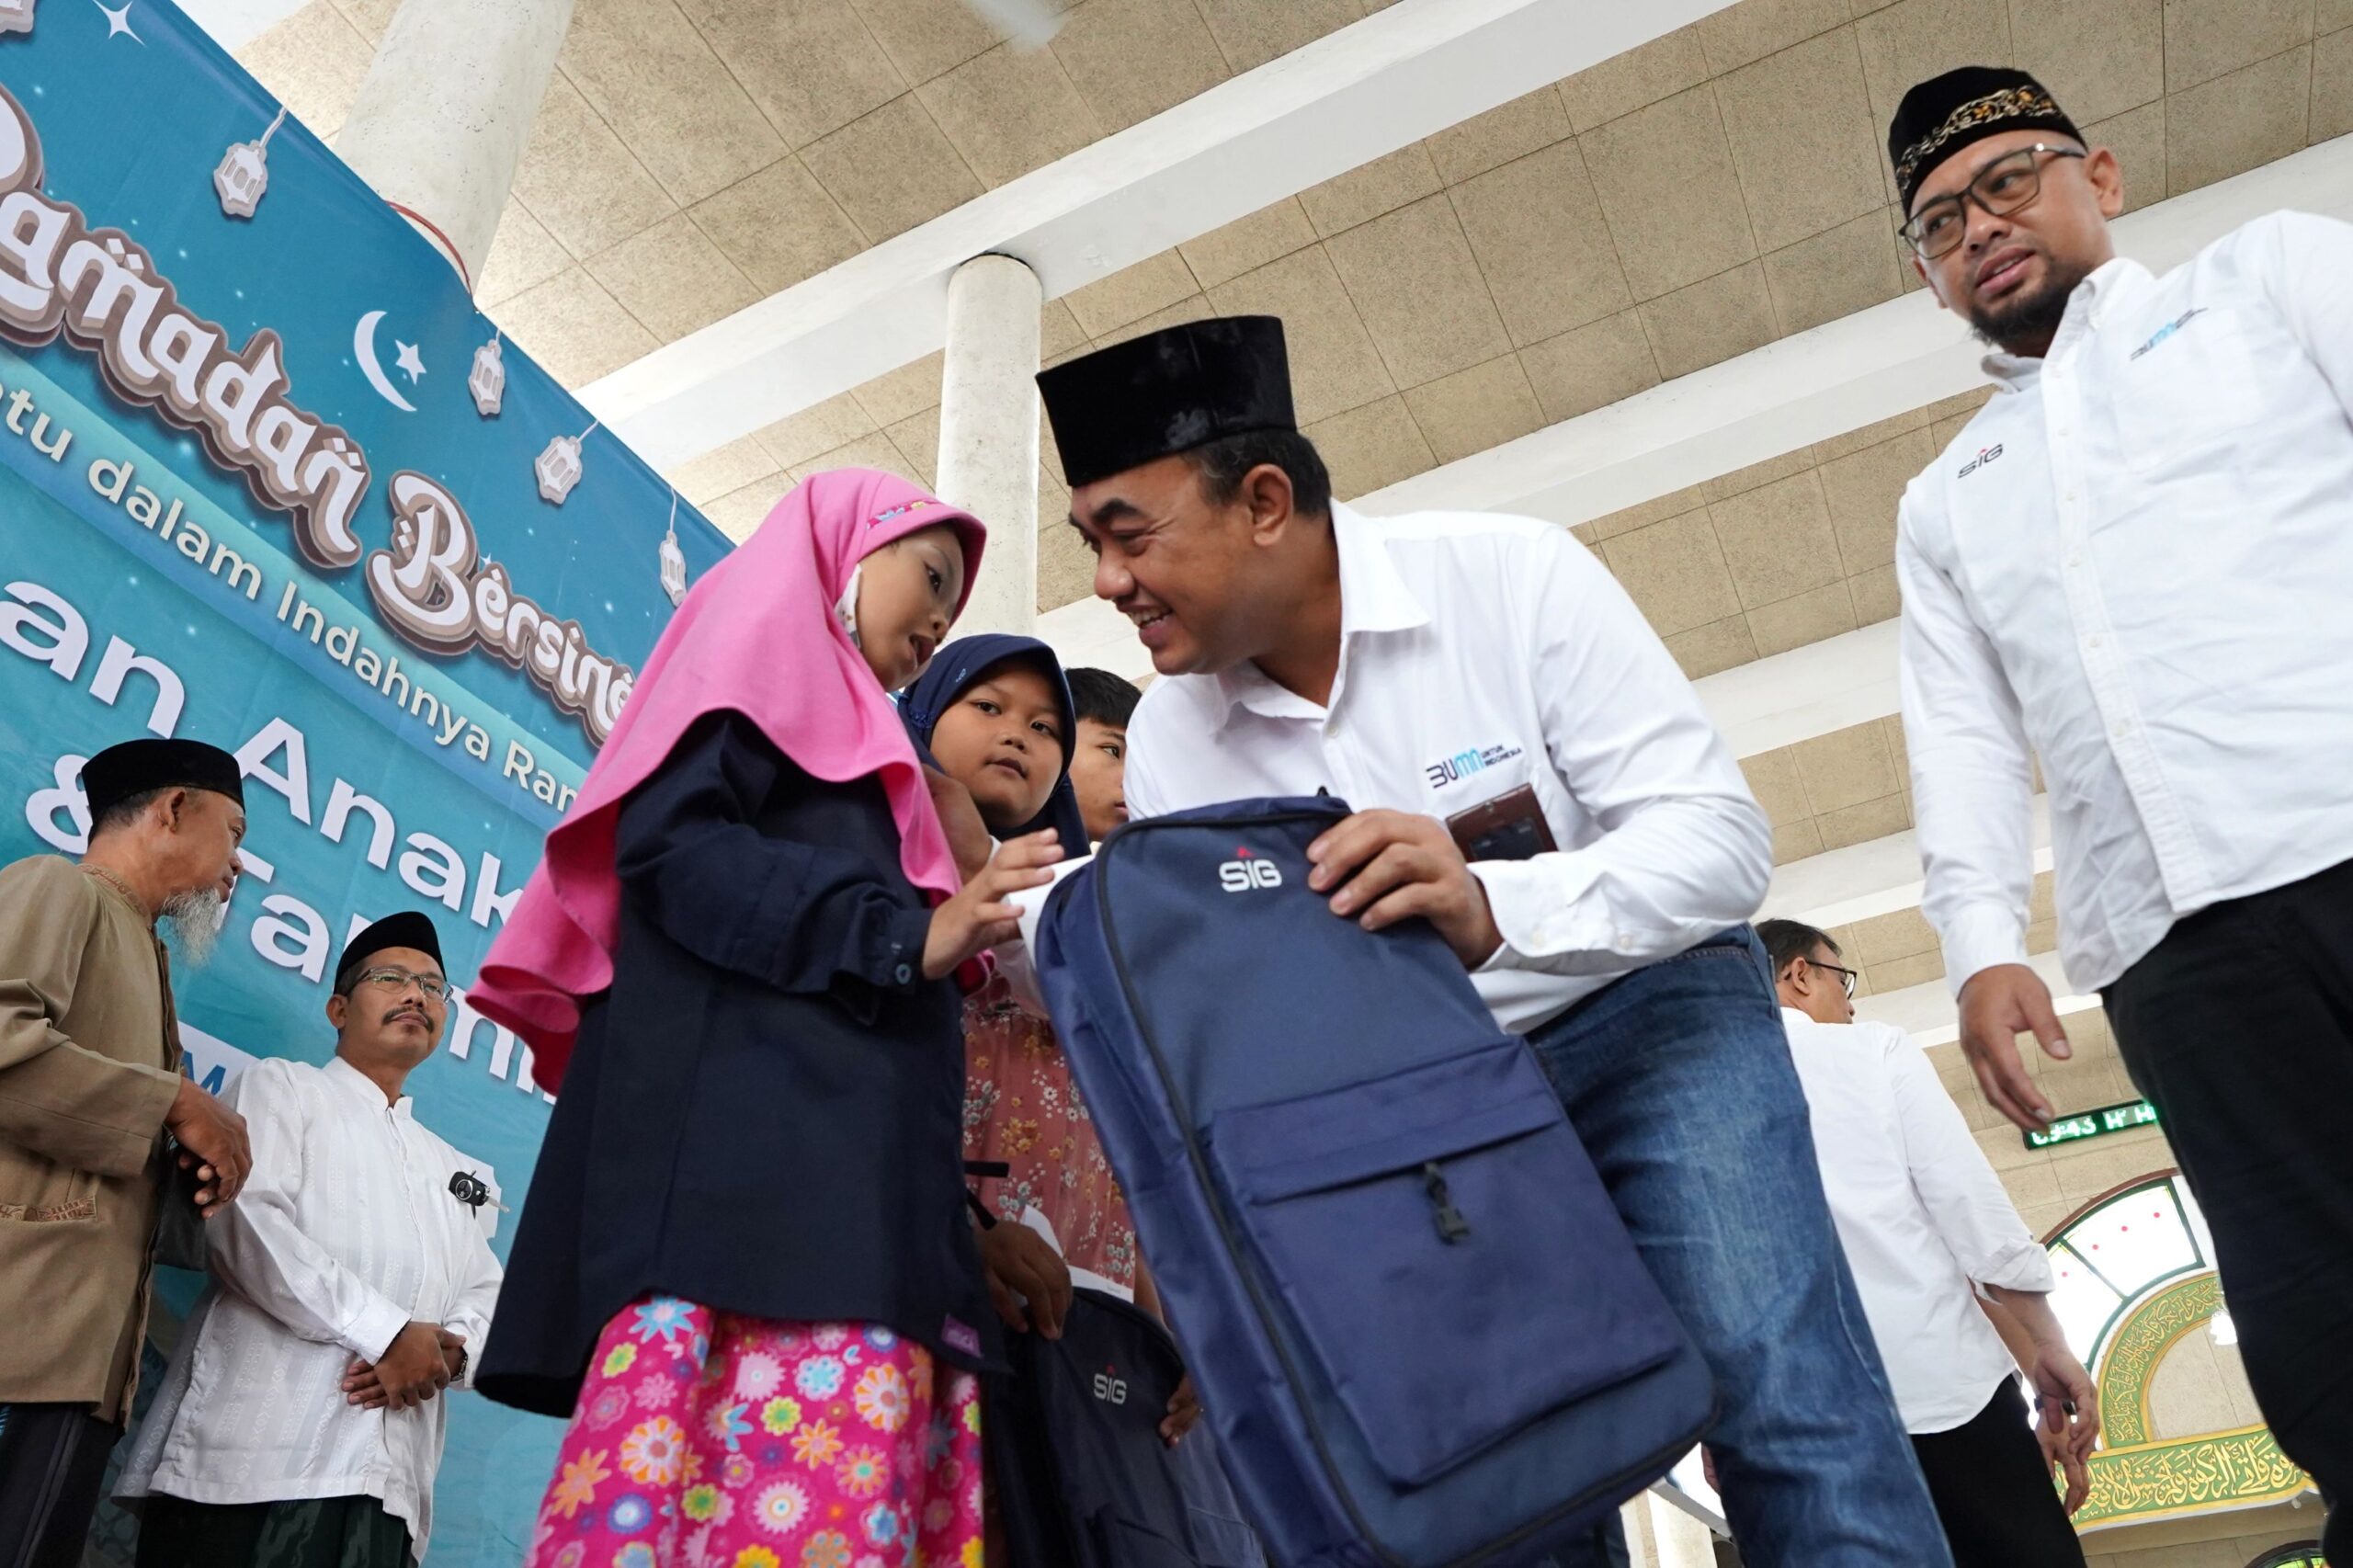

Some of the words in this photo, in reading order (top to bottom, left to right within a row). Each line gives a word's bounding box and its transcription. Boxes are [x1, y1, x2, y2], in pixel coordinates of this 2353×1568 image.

[1957, 443, 2004, 479] SIG
[0, 381, 74, 463] tu
[87, 458, 264, 601] dalam
[276, 580, 491, 763] Indahnya
[230, 716, 525, 928] Anak
[1218, 858, 1283, 892] SIG
[1094, 1372, 1127, 1405] SIG
